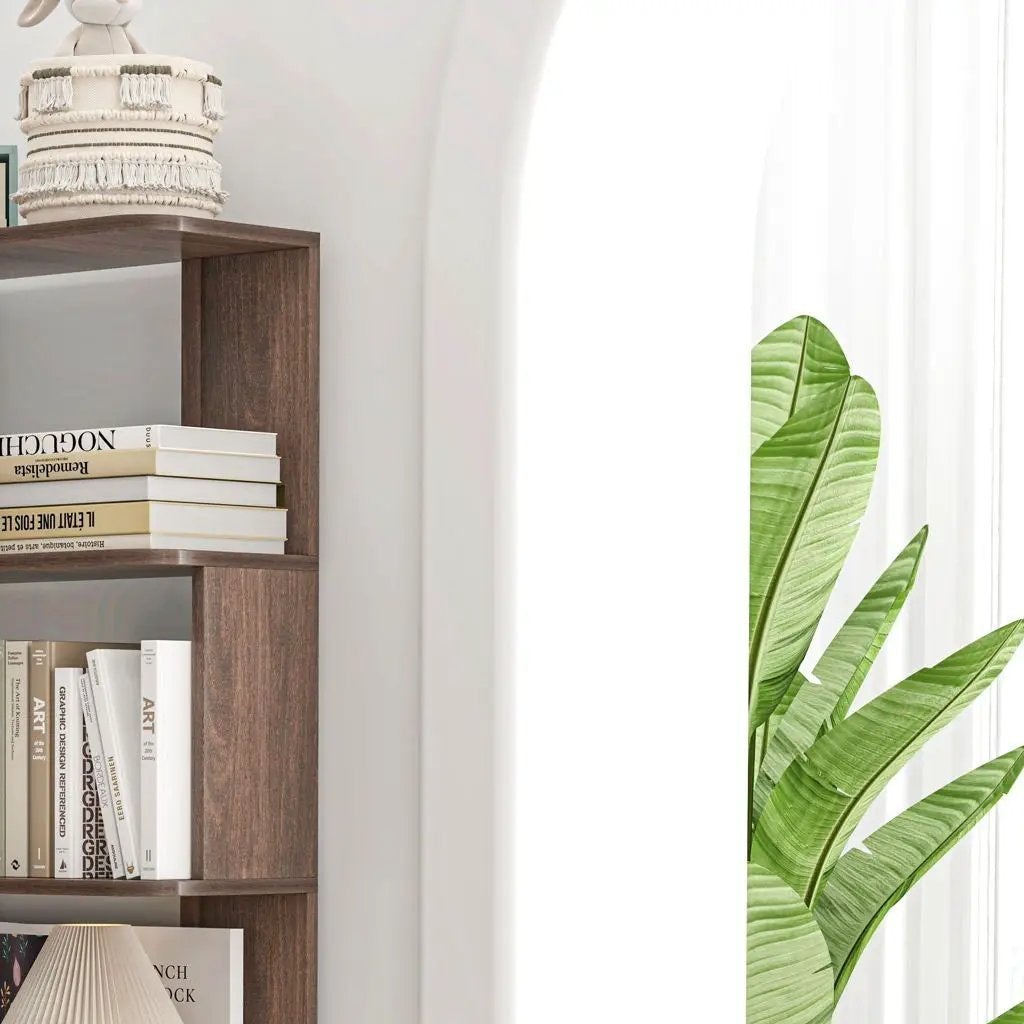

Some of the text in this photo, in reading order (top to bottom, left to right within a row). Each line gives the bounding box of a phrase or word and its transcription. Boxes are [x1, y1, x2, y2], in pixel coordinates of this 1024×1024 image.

[14, 461, 89, 479] Remodelista
[2, 515, 13, 532] LE
[15, 514, 35, 531] FOIS
[37, 513, 56, 530] UNE
[58, 512, 84, 531] ÉTAIT
[86, 511, 95, 527] IL
[33, 697, 45, 734] ART
[143, 697, 155, 735] ART
[93, 755, 109, 808] BORDEAUX
[108, 756, 125, 821] EERO SAARINEN
